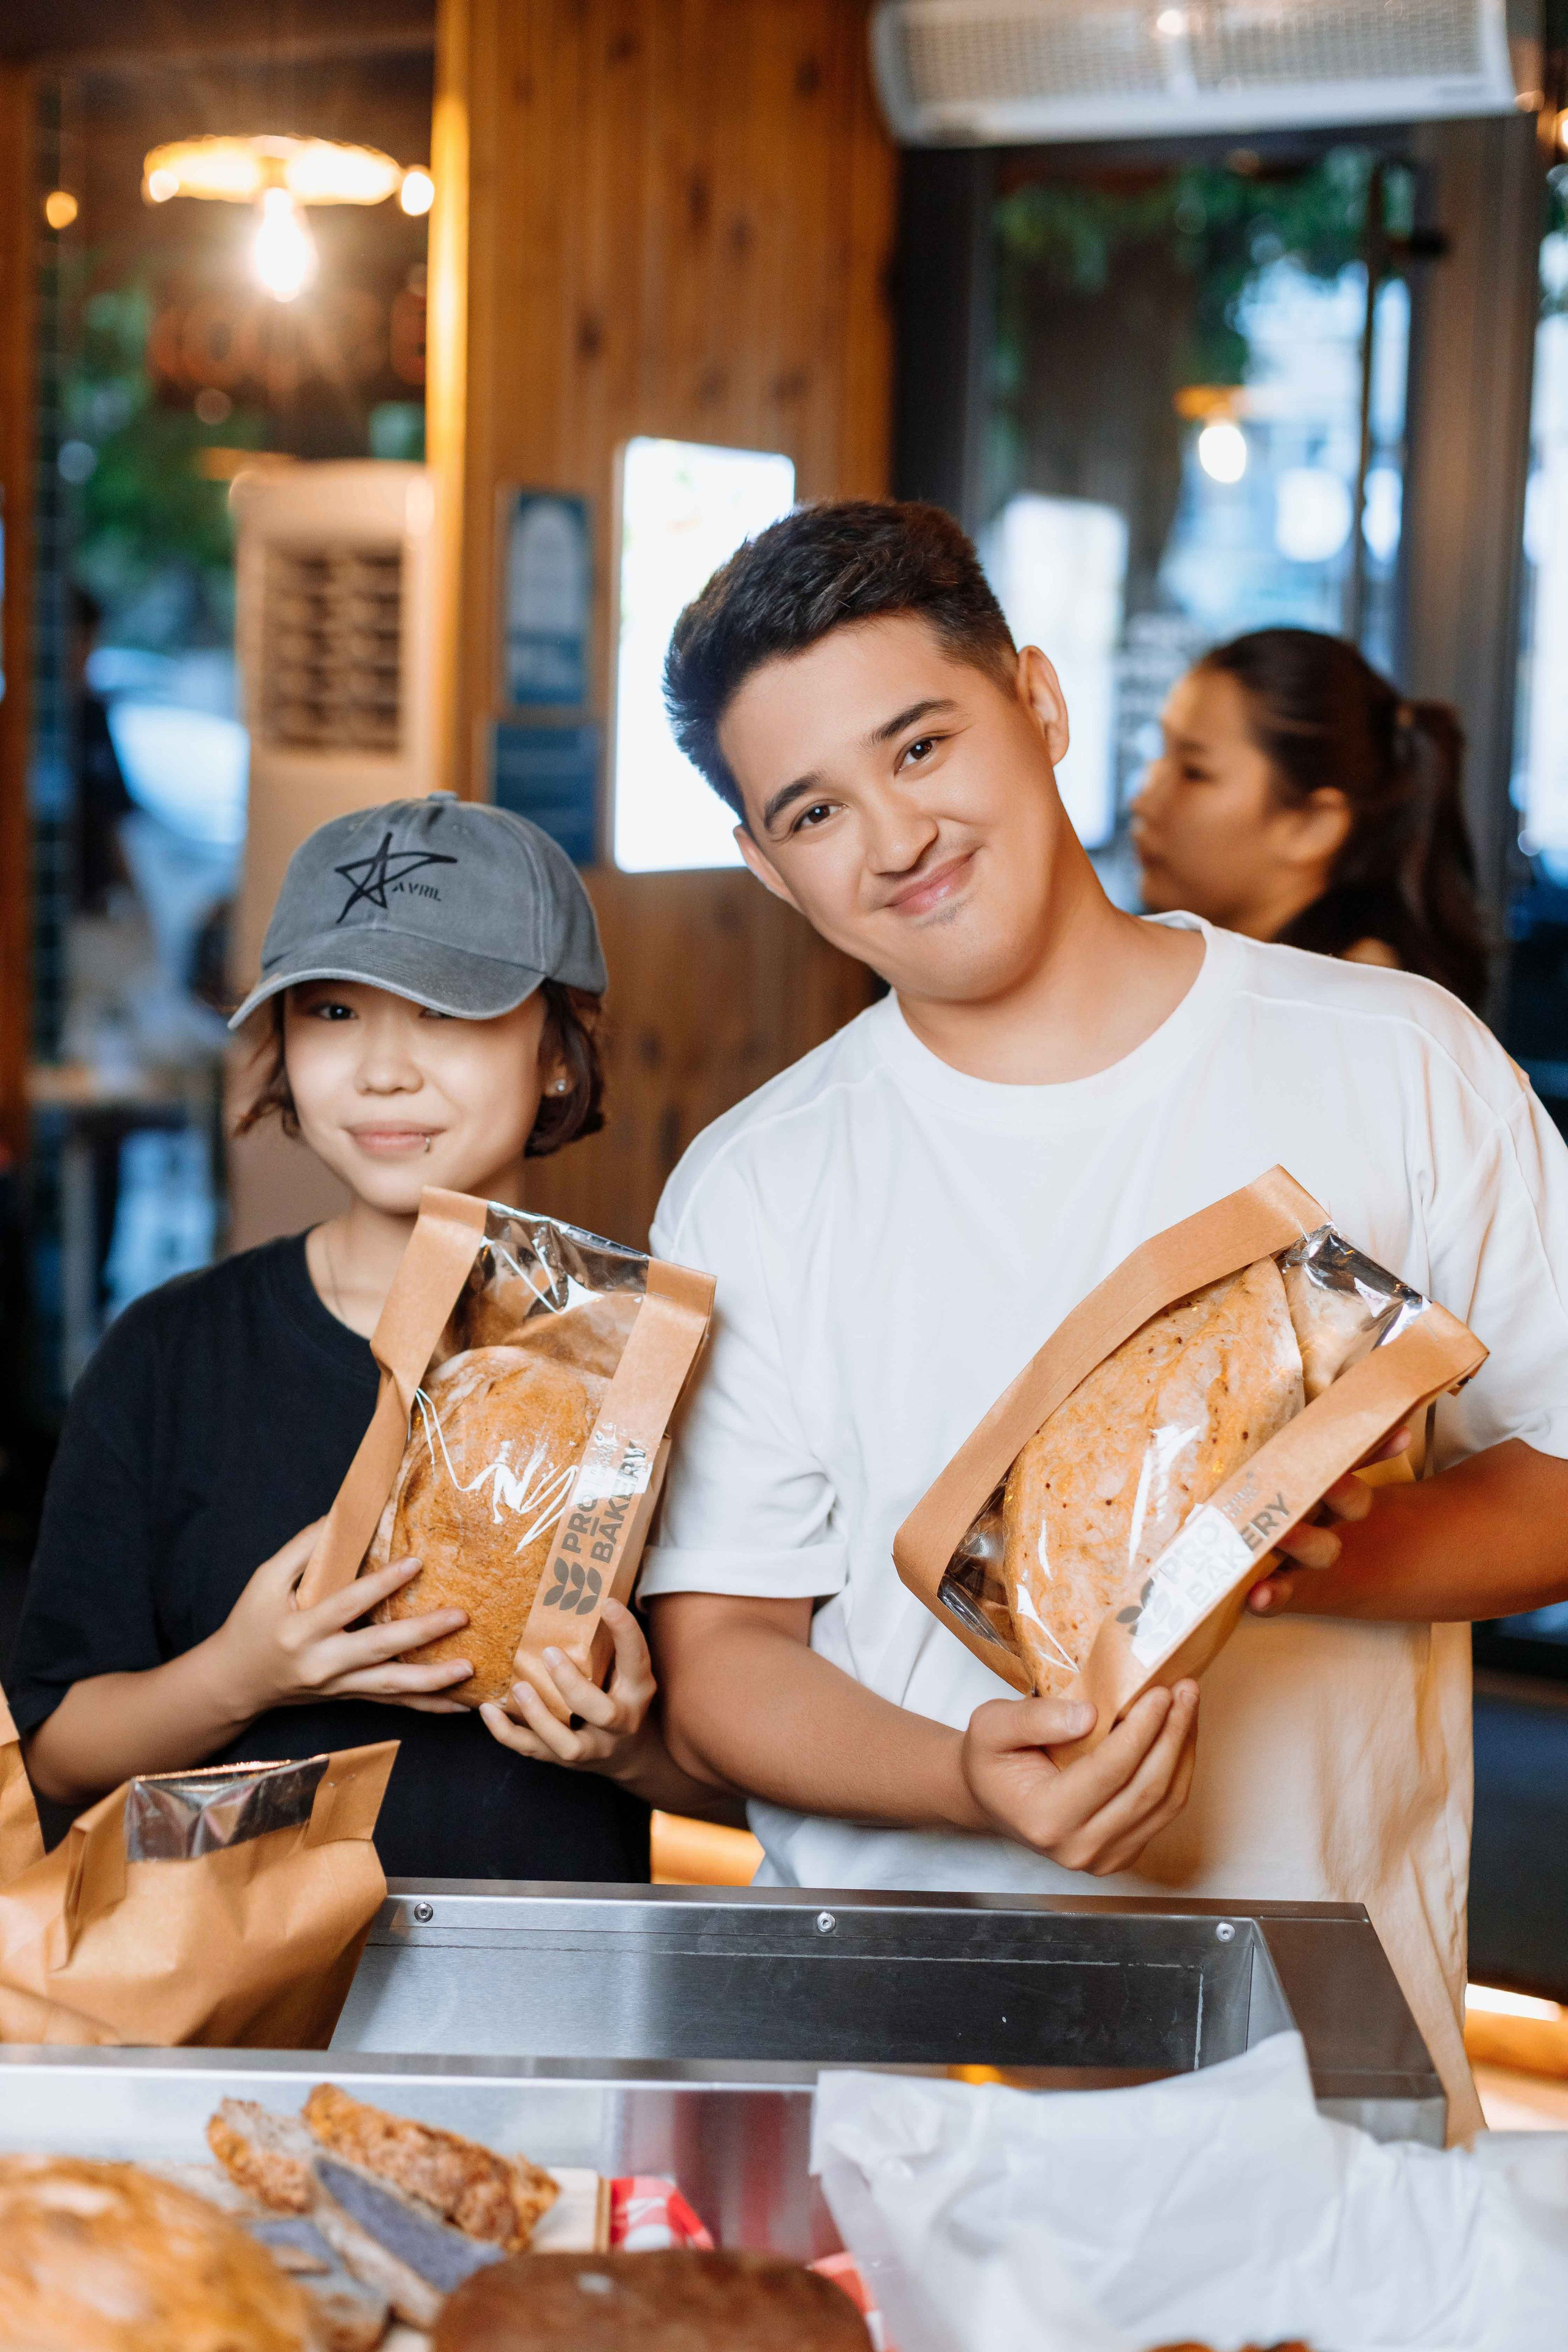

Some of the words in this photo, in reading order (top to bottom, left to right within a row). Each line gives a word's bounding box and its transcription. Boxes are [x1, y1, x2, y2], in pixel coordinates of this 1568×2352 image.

[392, 882, 442, 902] AVRIL
[562, 1490, 598, 1554] PRO
[590, 1439, 647, 1563] BAKERY
